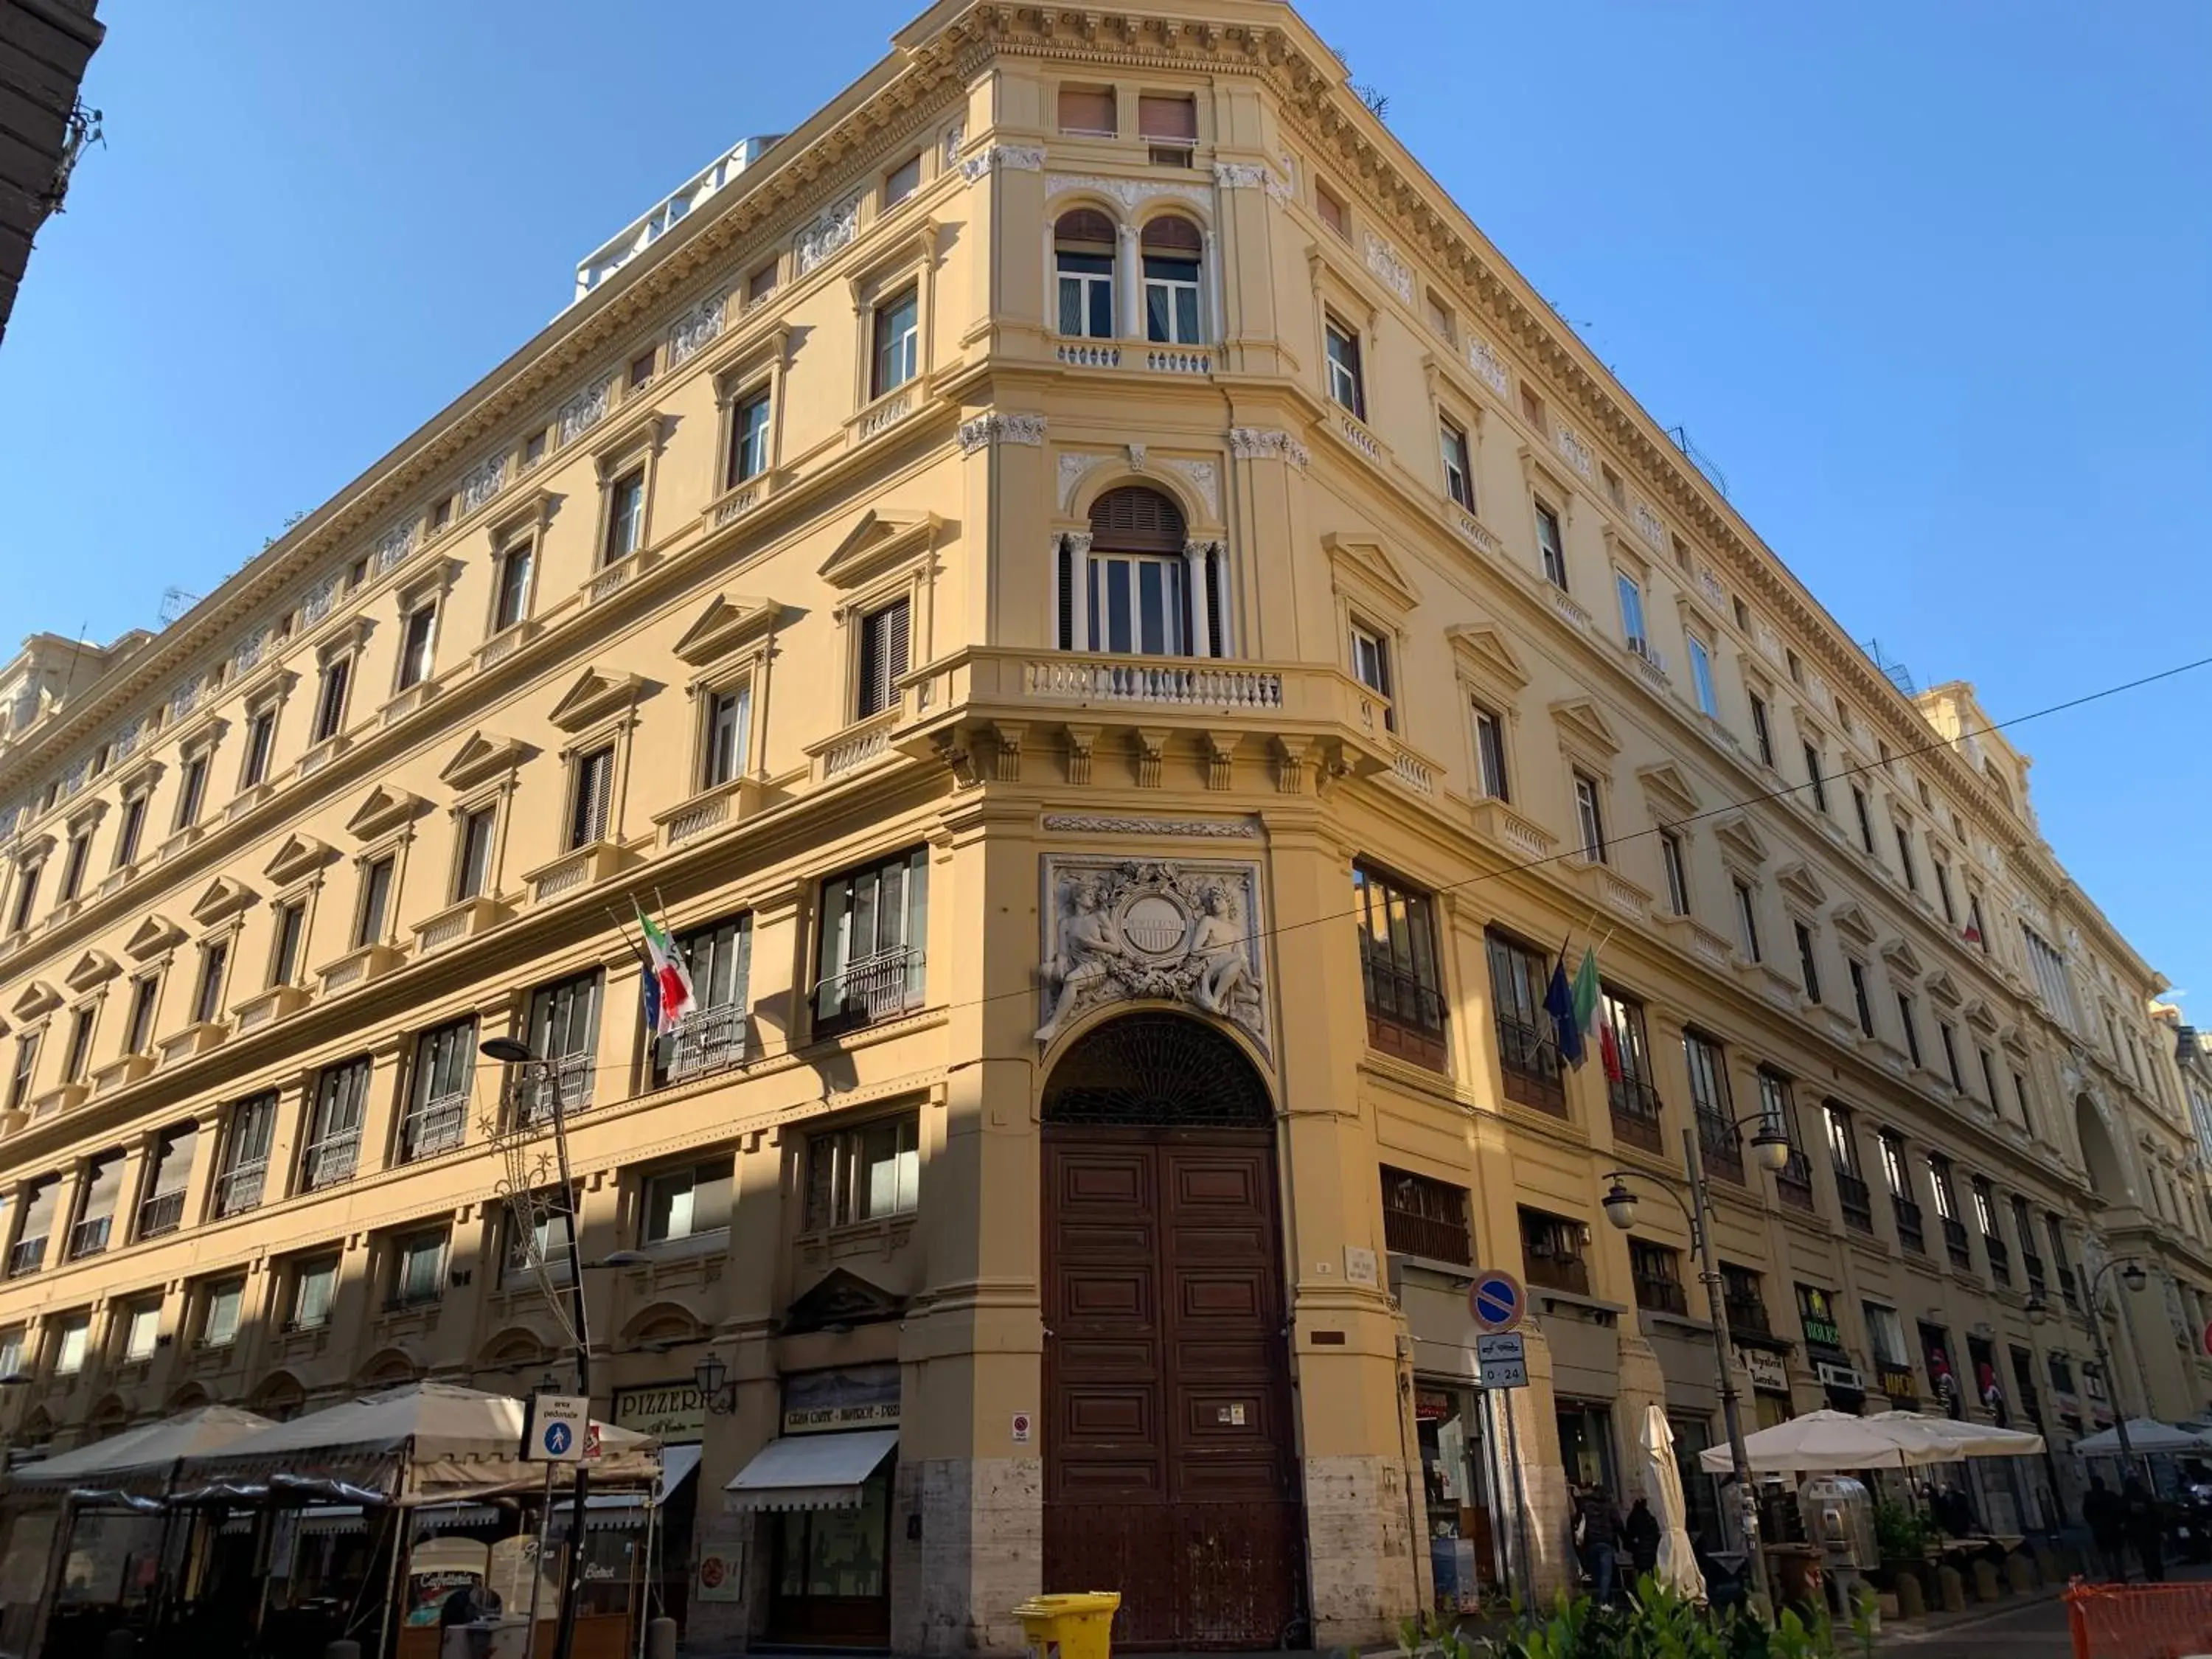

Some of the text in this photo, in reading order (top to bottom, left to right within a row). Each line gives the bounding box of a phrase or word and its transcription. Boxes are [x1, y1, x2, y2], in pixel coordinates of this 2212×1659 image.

[1487, 1370, 1495, 1380] 0
[1505, 1368, 1520, 1379] 24
[544, 1410, 579, 1419] pedonale
